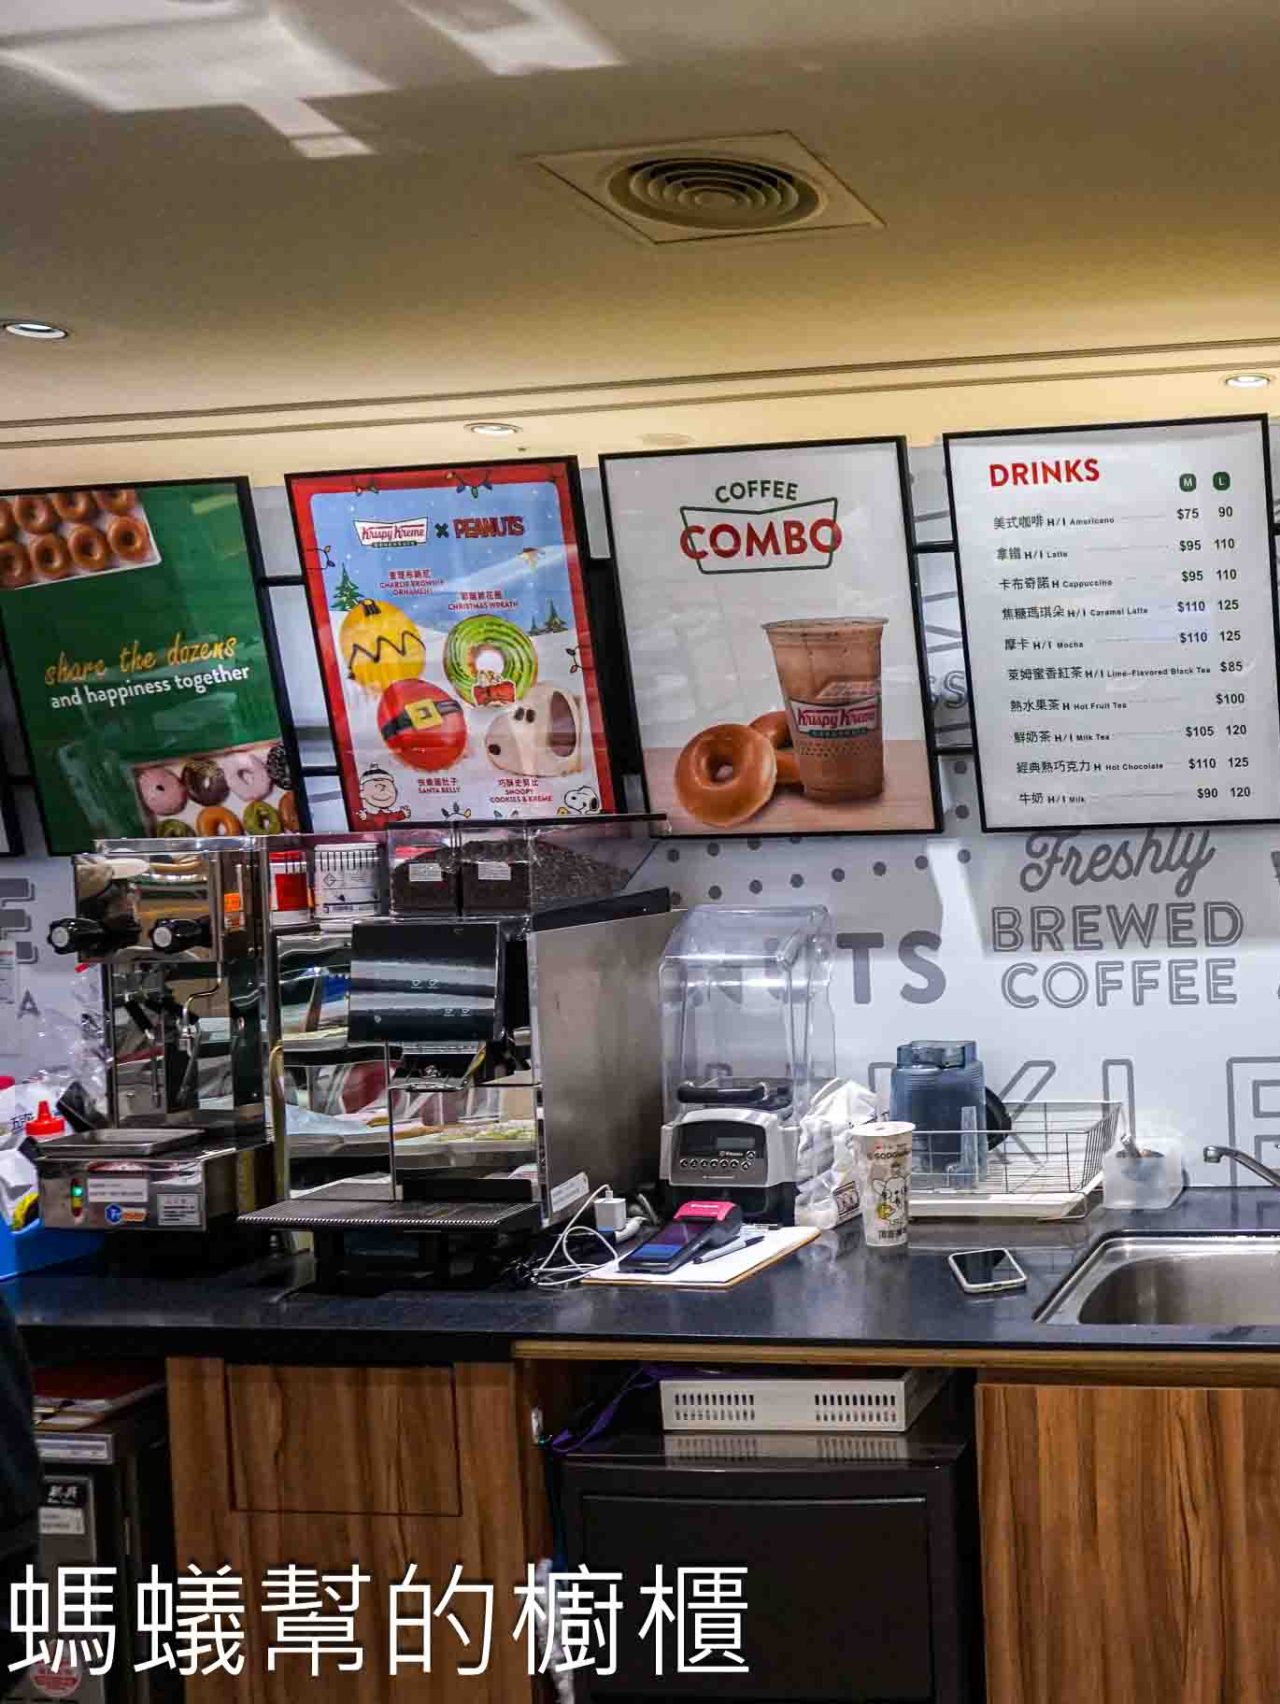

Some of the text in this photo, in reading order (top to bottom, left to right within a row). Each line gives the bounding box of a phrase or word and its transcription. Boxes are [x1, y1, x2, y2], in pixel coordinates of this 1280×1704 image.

[989, 459, 1100, 487] DRINKS
[715, 479, 799, 503] COFFEE
[452, 516, 525, 539] PEANUTS
[993, 515, 1043, 530] 美式咖啡
[1177, 508, 1199, 520] $75
[1218, 506, 1233, 517] 90
[680, 518, 843, 560] COMBO
[1179, 539, 1202, 552] $95
[1214, 537, 1235, 549] 110
[998, 576, 1050, 591] 卡布奇諾
[1181, 570, 1204, 583] $95
[1216, 568, 1237, 580] 110
[1002, 605, 1065, 621] 焦糖瑪琪朵
[1177, 601, 1206, 613] $110
[1218, 599, 1239, 611] 125
[1005, 638, 1029, 651] 摩卡
[1179, 631, 1208, 644] $110
[1219, 630, 1241, 642] 125
[44, 633, 238, 687] share the dozens
[1007, 666, 1083, 681] 萊姆蜜香紅茶
[1219, 661, 1243, 673] $85
[51, 665, 250, 709] and happiness together
[1010, 699, 1060, 713] 熱水果茶
[1215, 693, 1245, 705] $100
[1013, 730, 1051, 744] 鮮奶茶
[1185, 726, 1214, 738] $105
[1226, 724, 1247, 736] 120
[1016, 759, 1091, 774] 經典熱巧克力
[1188, 758, 1216, 770] $110
[1228, 757, 1249, 768] 125
[1018, 792, 1044, 806] 牛奶
[1197, 788, 1218, 800] $90
[1230, 786, 1251, 797] 120
[1020, 828, 1216, 898] Freshly
[992, 902, 1244, 952] BREWED
[1001, 958, 1238, 1009] COFFEE
